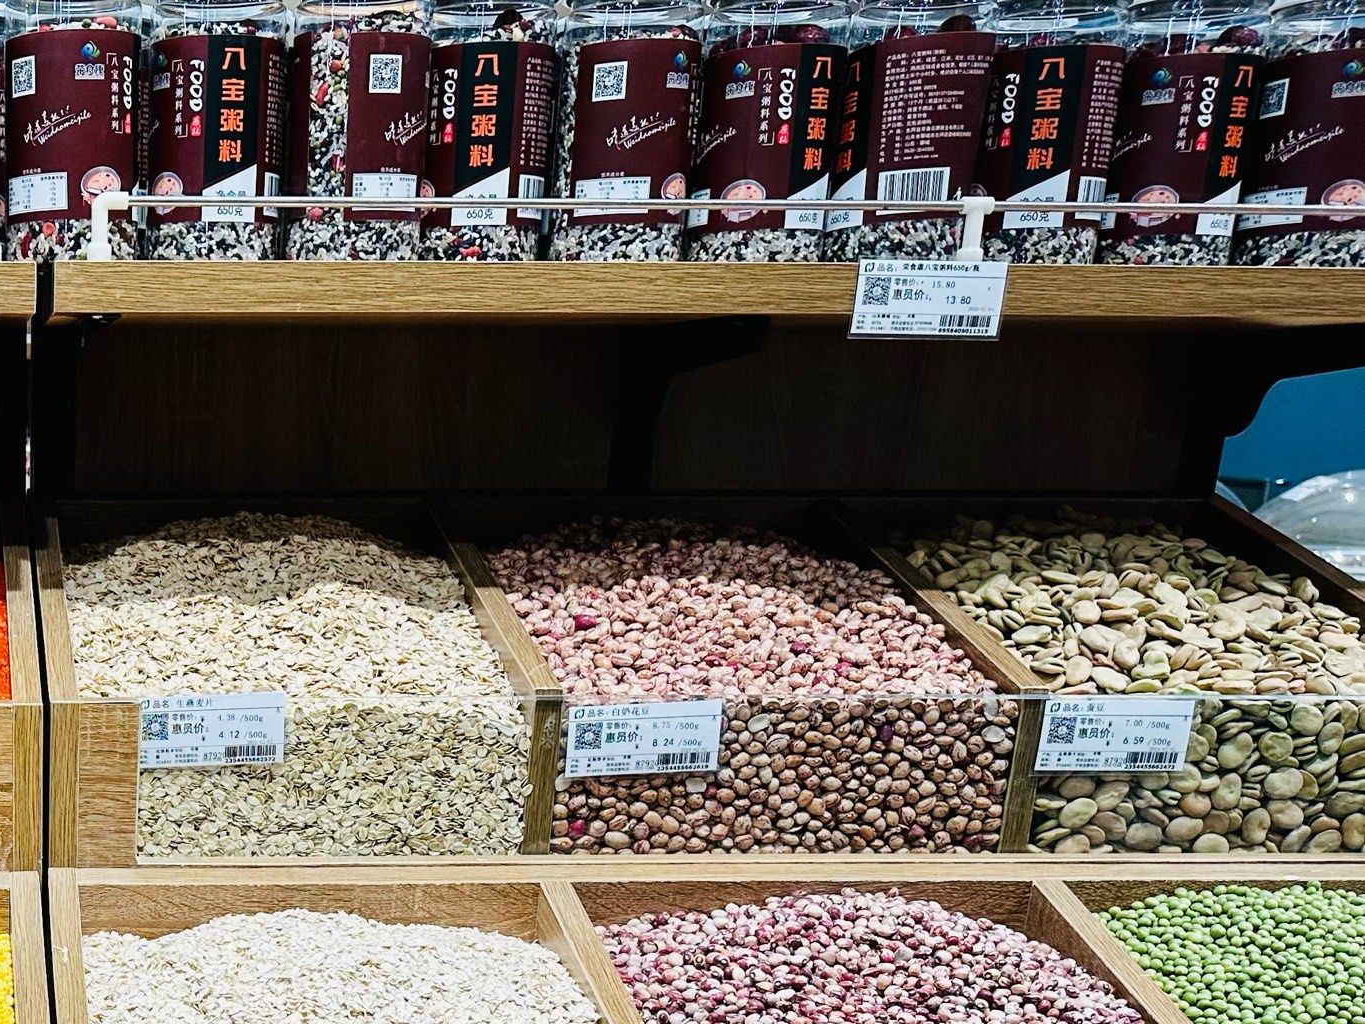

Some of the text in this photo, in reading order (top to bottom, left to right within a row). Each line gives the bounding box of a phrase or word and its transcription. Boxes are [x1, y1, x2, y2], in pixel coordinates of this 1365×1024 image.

[123, 56, 132, 109] FOOD
[190, 60, 204, 111] FOOD
[219, 48, 246, 162] 八宝粥料
[443, 69, 457, 119] FOOD
[778, 68, 796, 120] FOOD
[1002, 74, 1020, 123] FOOD
[1197, 77, 1219, 127] FOOD
[469, 54, 499, 167] 八宝粥料
[804, 57, 831, 170] 八宝粥料
[1027, 58, 1066, 170] 八宝粥料
[1219, 66, 1253, 177] 八宝粥料
[467, 210, 493, 219] 650克
[799, 213, 817, 223] 650克
[1020, 212, 1049, 222] 650克
[244, 731, 267, 739] /500g
[675, 722, 699, 730] /500g
[678, 739, 702, 747] /500g
[1147, 721, 1170, 729] /500g
[1148, 738, 1172, 746] /500g
